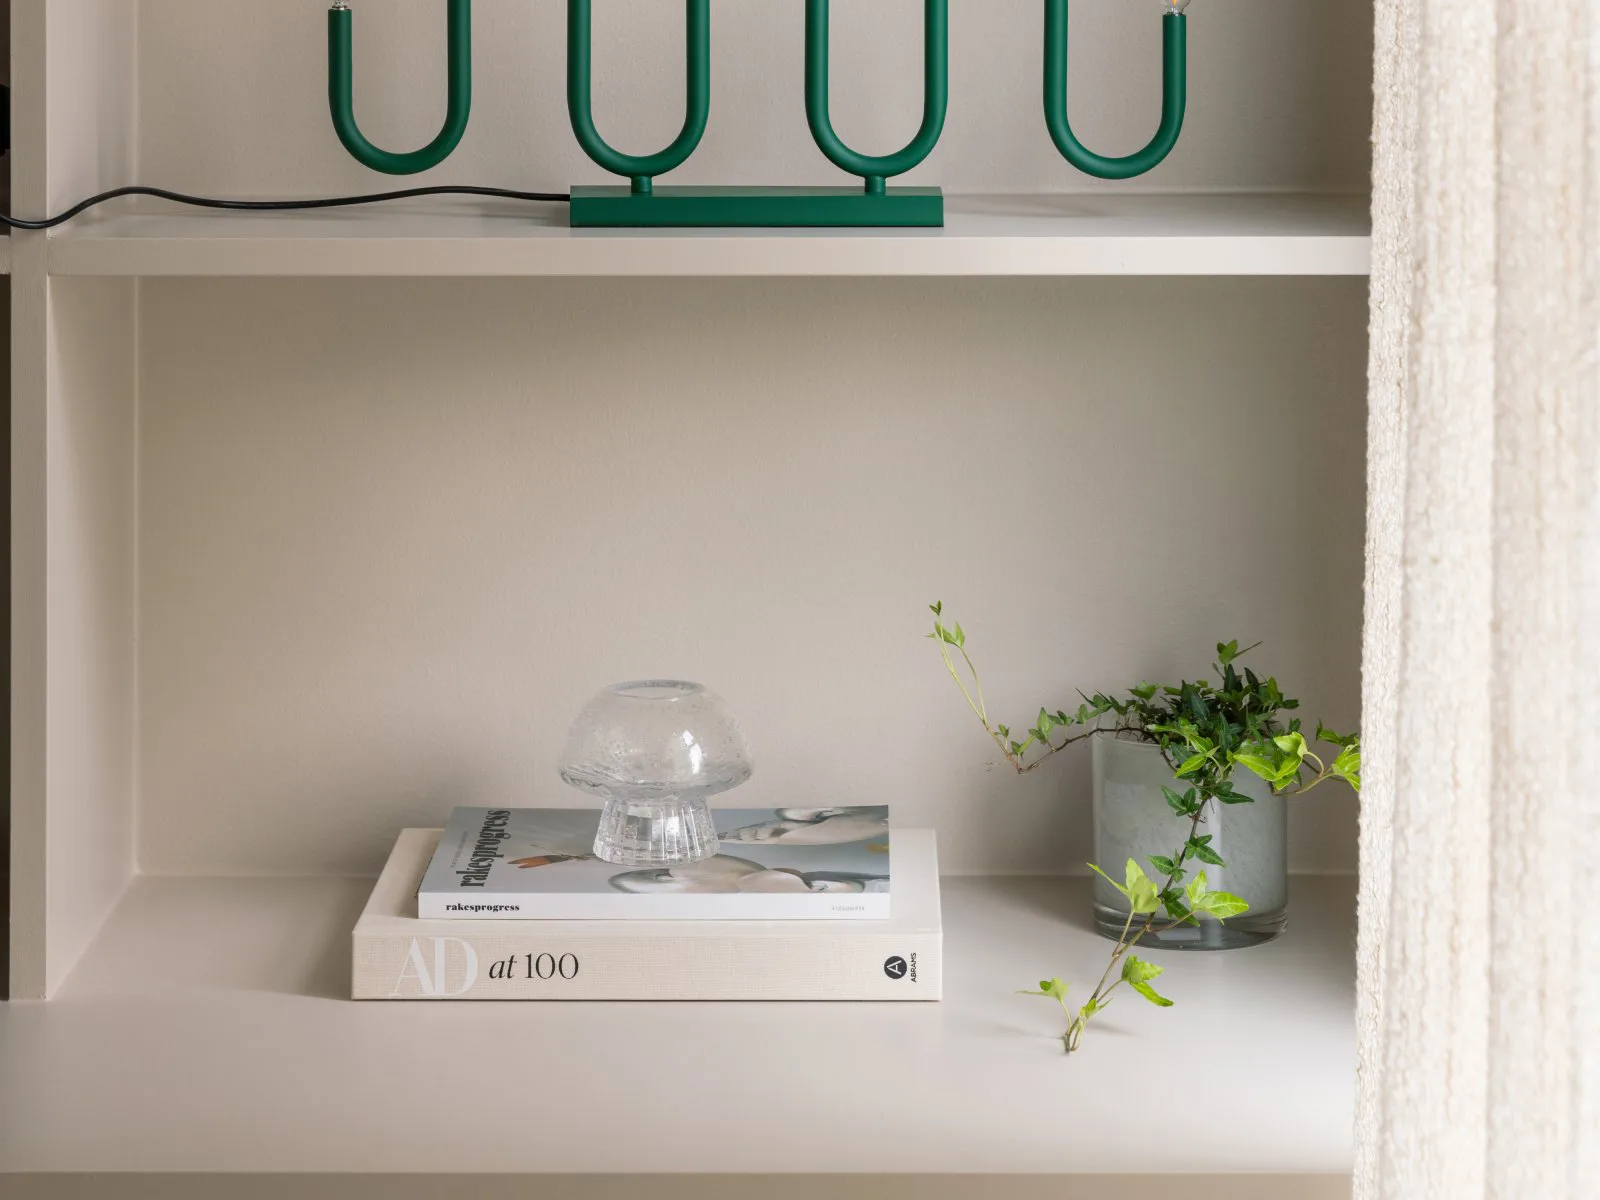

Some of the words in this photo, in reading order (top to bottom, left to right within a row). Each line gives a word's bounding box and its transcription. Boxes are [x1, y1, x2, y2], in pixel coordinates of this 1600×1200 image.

[456, 810, 511, 887] rakesprogress
[446, 902, 520, 912] rakesprogress
[389, 936, 479, 996] AD
[488, 953, 518, 979] at
[524, 952, 579, 980] 100
